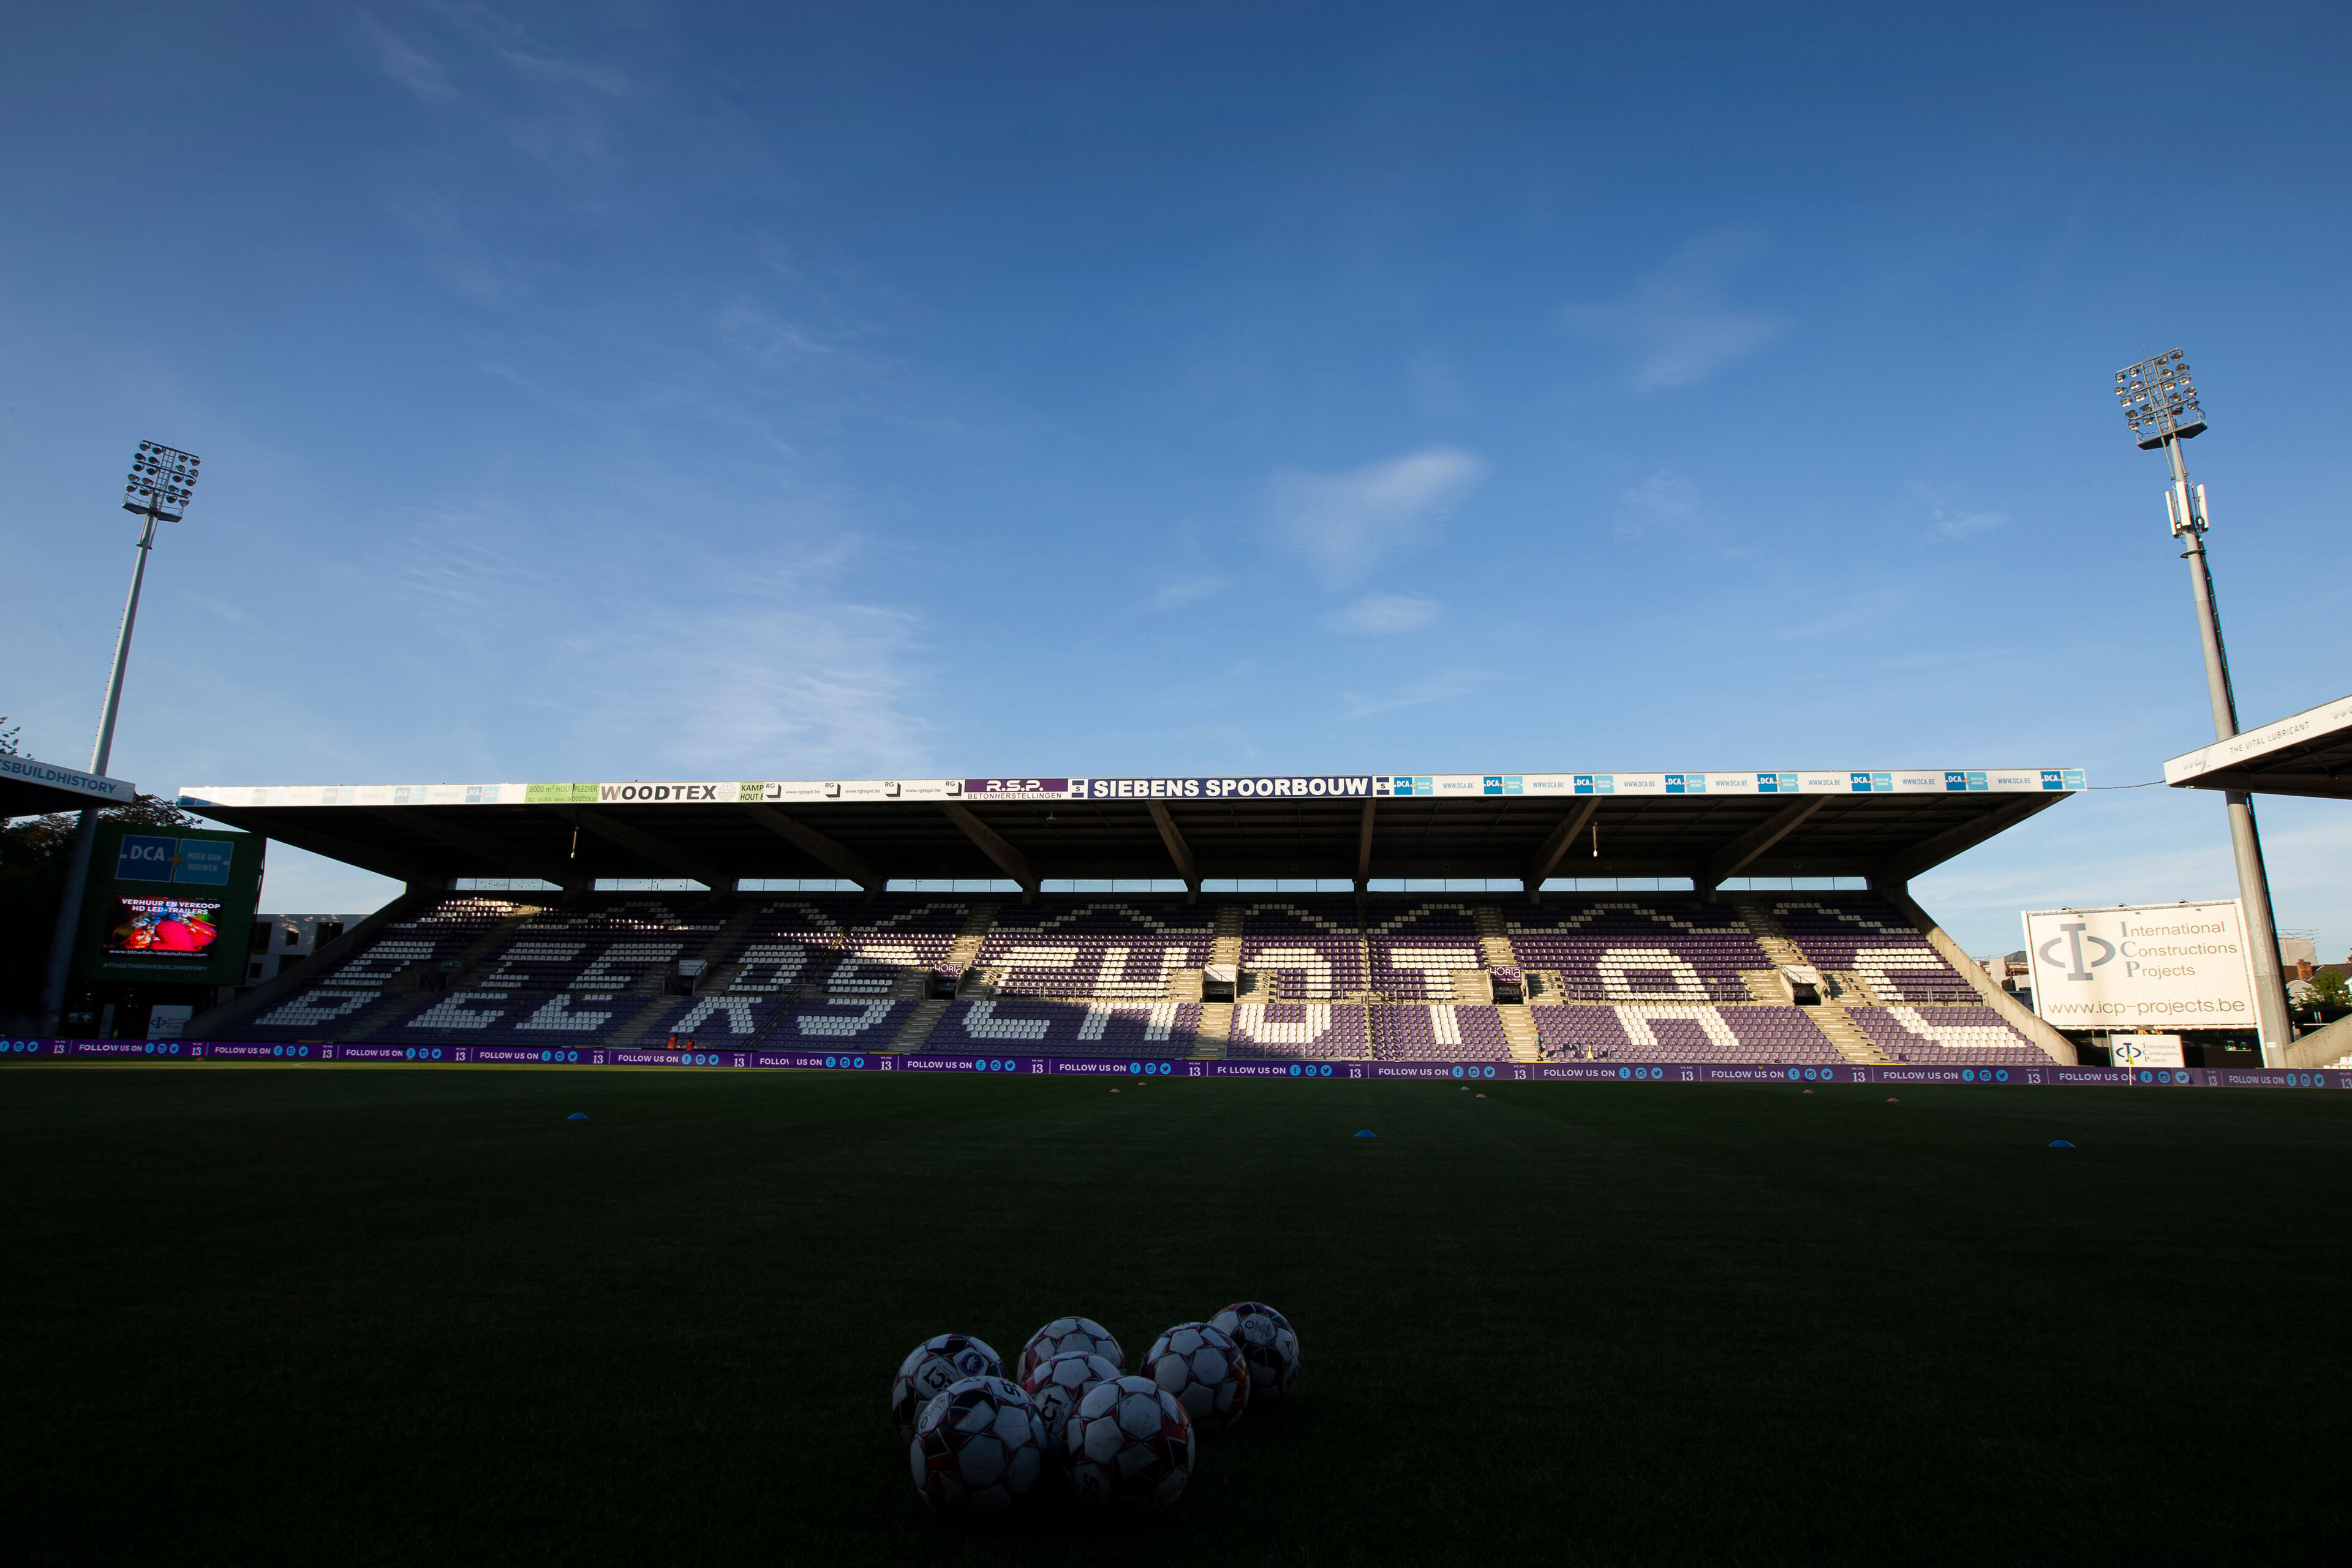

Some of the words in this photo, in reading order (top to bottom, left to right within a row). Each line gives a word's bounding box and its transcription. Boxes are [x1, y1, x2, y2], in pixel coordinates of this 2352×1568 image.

[2230, 745, 2243, 755] THE
[2245, 737, 2265, 750] VITAL
[2267, 721, 2310, 742] LUBRICANT
[986, 780, 1044, 792] R.S.P.
[1093, 780, 1200, 798] SIEBENS
[1205, 778, 1368, 797] SPOORBOUW
[601, 785, 717, 801] WOODTEX
[129, 845, 165, 862] DCA
[187, 852, 206, 861] MEER
[187, 862, 217, 872] BOUWEN
[2119, 921, 2225, 938] International
[2120, 940, 2237, 958] Constructions
[103, 962, 208, 971] #TOGETHERWEBUILDHISTORY
[2125, 960, 2195, 979] Projects
[2047, 998, 2245, 1016] www.icp-projects.be
[53, 1044, 64, 1054] 13
[192, 1047, 202, 1056] 13
[322, 1049, 332, 1058] 13
[455, 1052, 466, 1061] 13
[593, 1055, 603, 1064] 13
[734, 1058, 745, 1067] 13
[881, 1061, 892, 1071] 13
[1031, 1063, 1044, 1074] 13
[1189, 1066, 1201, 1077] 13
[1349, 1068, 1362, 1079] 13
[1514, 1069, 1527, 1080] 13
[1681, 1071, 1694, 1081] 13
[1853, 1071, 1866, 1082] 13
[2028, 1073, 2041, 1084] 13
[2208, 1076, 2217, 1086] 13
[2340, 1078, 2352, 1089] 13
